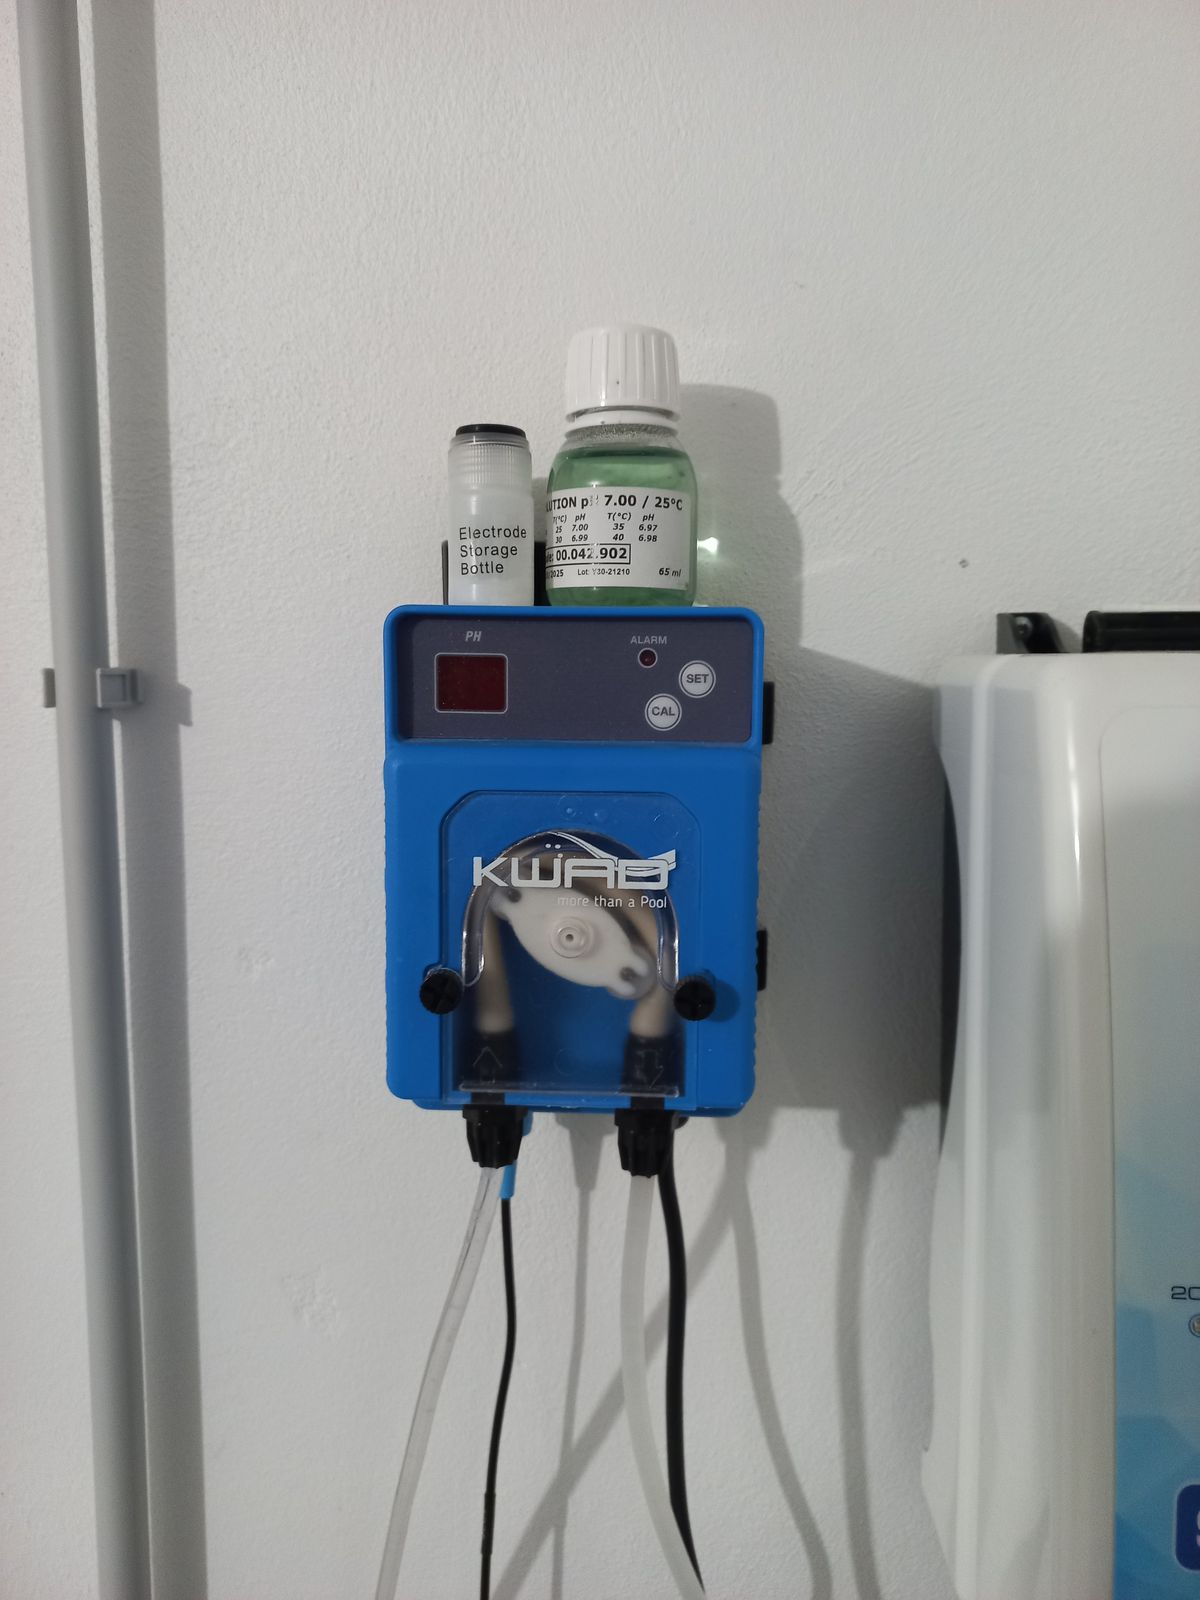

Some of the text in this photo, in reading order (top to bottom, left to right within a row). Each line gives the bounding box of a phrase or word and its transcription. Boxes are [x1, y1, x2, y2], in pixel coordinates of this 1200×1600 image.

[581, 495, 600, 510] p
[604, 494, 637, 507] 7.00
[642, 495, 649, 509] /
[654, 496, 683, 511] 25°C
[575, 513, 586, 522] pH
[607, 512, 655, 522] T(°C) pH
[459, 525, 527, 540] Electrode
[571, 523, 589, 532] 7.00
[612, 523, 658, 532] 35 6.97
[571, 534, 589, 542] 6.99
[612, 533, 658, 542] 40 6.98
[460, 544, 518, 559] Storage
[556, 547, 628, 561] 00.042.902
[460, 561, 504, 575] Bottle
[658, 567, 682, 577] 65 ml
[465, 630, 482, 642] PH
[630, 635, 668, 645] ALARM
[686, 673, 710, 684] SET
[651, 706, 676, 717] CAL
[557, 895, 667, 909] more than a Pool
